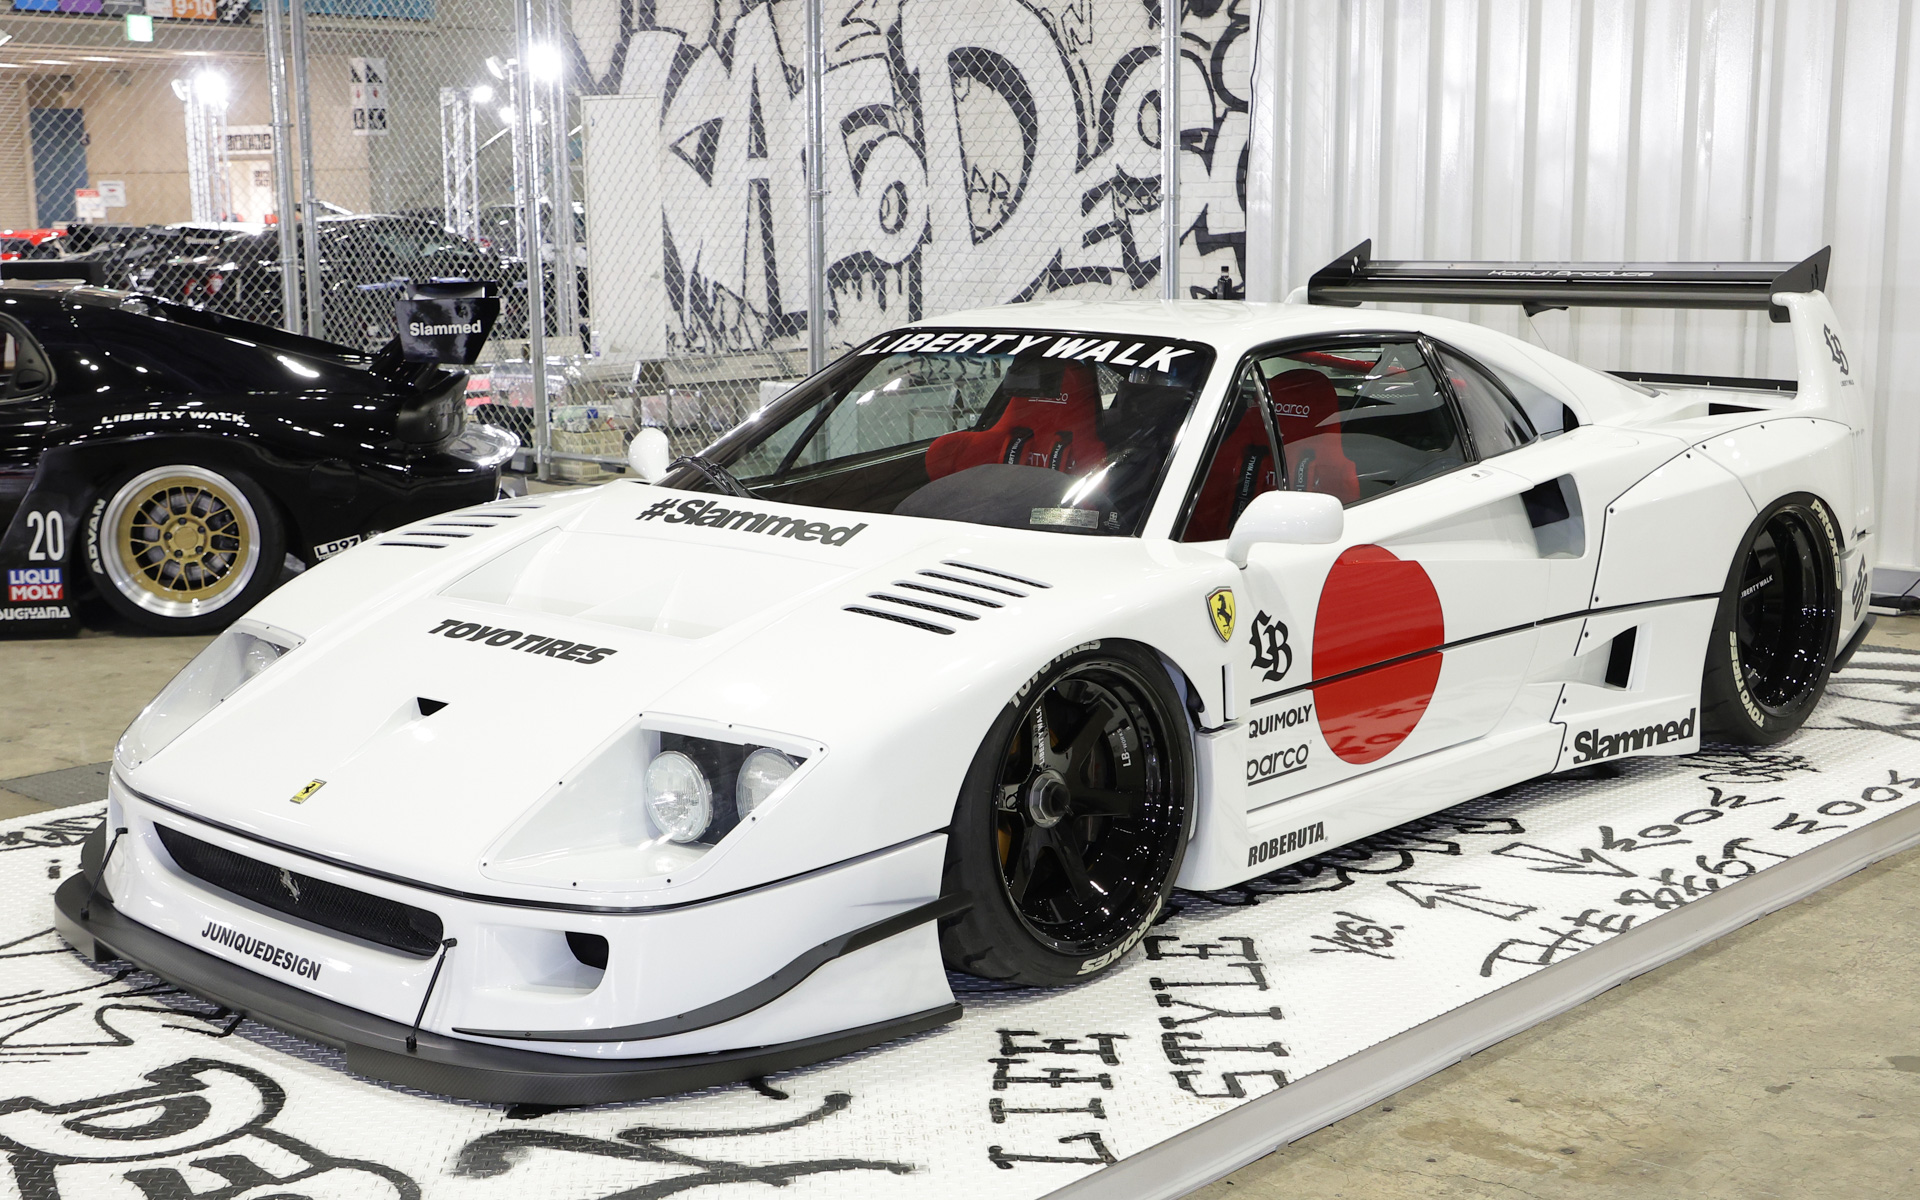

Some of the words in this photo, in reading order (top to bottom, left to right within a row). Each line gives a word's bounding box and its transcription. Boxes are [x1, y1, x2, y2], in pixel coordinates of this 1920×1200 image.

[409, 319, 482, 337] Slammed
[856, 332, 1053, 357] LIBERTY
[1041, 336, 1196, 374] WALK
[101, 410, 187, 425] LIBERTY
[188, 410, 247, 423] WALK
[1274, 402, 1310, 416] parco
[26, 509, 65, 562] 20
[87, 498, 106, 575] ADVAN
[635, 498, 869, 547] #Slammed
[316, 536, 359, 557] LD97
[1810, 498, 1843, 592] PROXES
[9, 568, 61, 585] LIQUI
[10, 584, 63, 601] MOLY
[1740, 581, 1760, 599] IBERTY
[1759, 574, 1774, 588] WALK
[427, 618, 524, 647] TOYO
[510, 634, 619, 665] TIRES
[1729, 630, 1746, 693] TIRES
[1035, 705, 1043, 732] WALK
[1248, 703, 1313, 739] QUIMOLY
[1740, 689, 1765, 728] TOYO
[1038, 731, 1046, 766] LIBERTY
[1572, 706, 1697, 765] Slammed
[1246, 743, 1310, 782] parco
[1247, 820, 1325, 868] ROBERUTA
[201, 921, 322, 981] JUNIQUEDESIGN
[1076, 894, 1163, 976] PROXES
[1142, 934, 1291, 1099] STYLE
[987, 1027, 1133, 1171] LIFE
